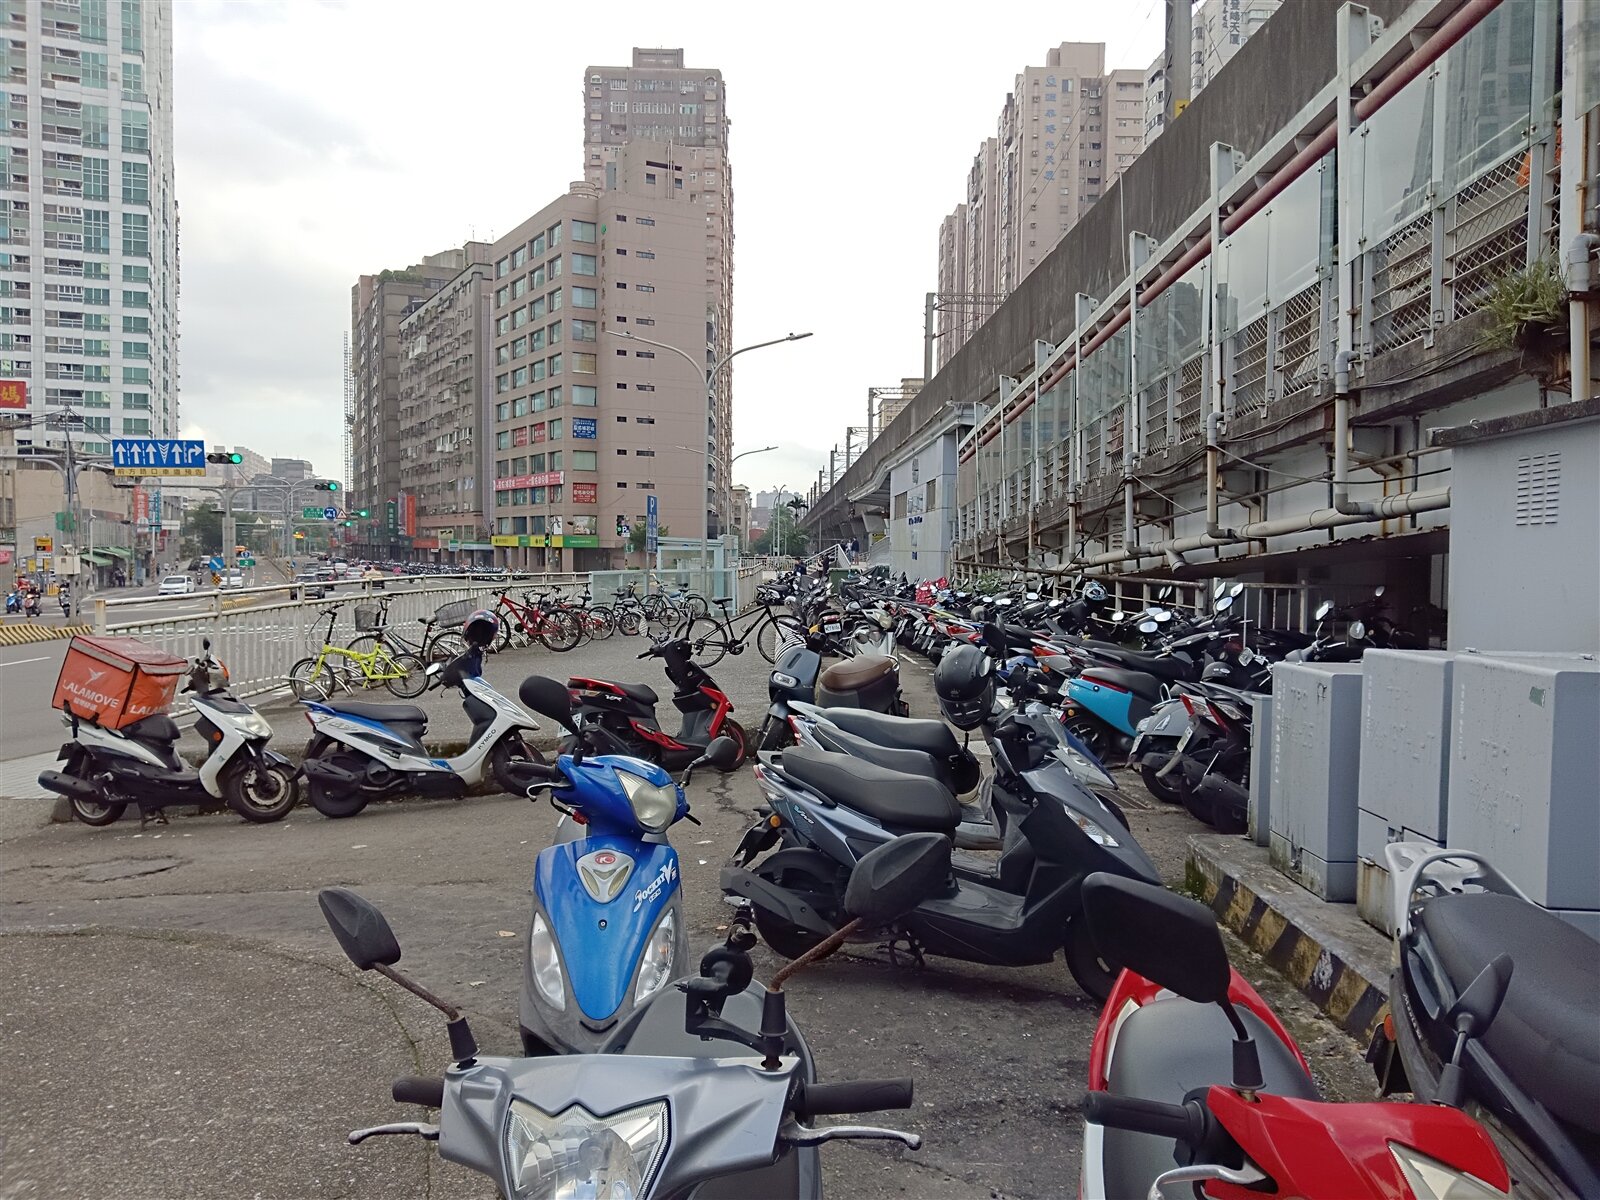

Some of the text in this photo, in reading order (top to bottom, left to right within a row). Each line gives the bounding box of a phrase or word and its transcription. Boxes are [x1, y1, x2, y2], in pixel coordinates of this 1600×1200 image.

[116, 467, 204, 477] 前方路口車道預告
[62, 680, 120, 708] LALAMOVE
[477, 729, 496, 750] KYMCO
